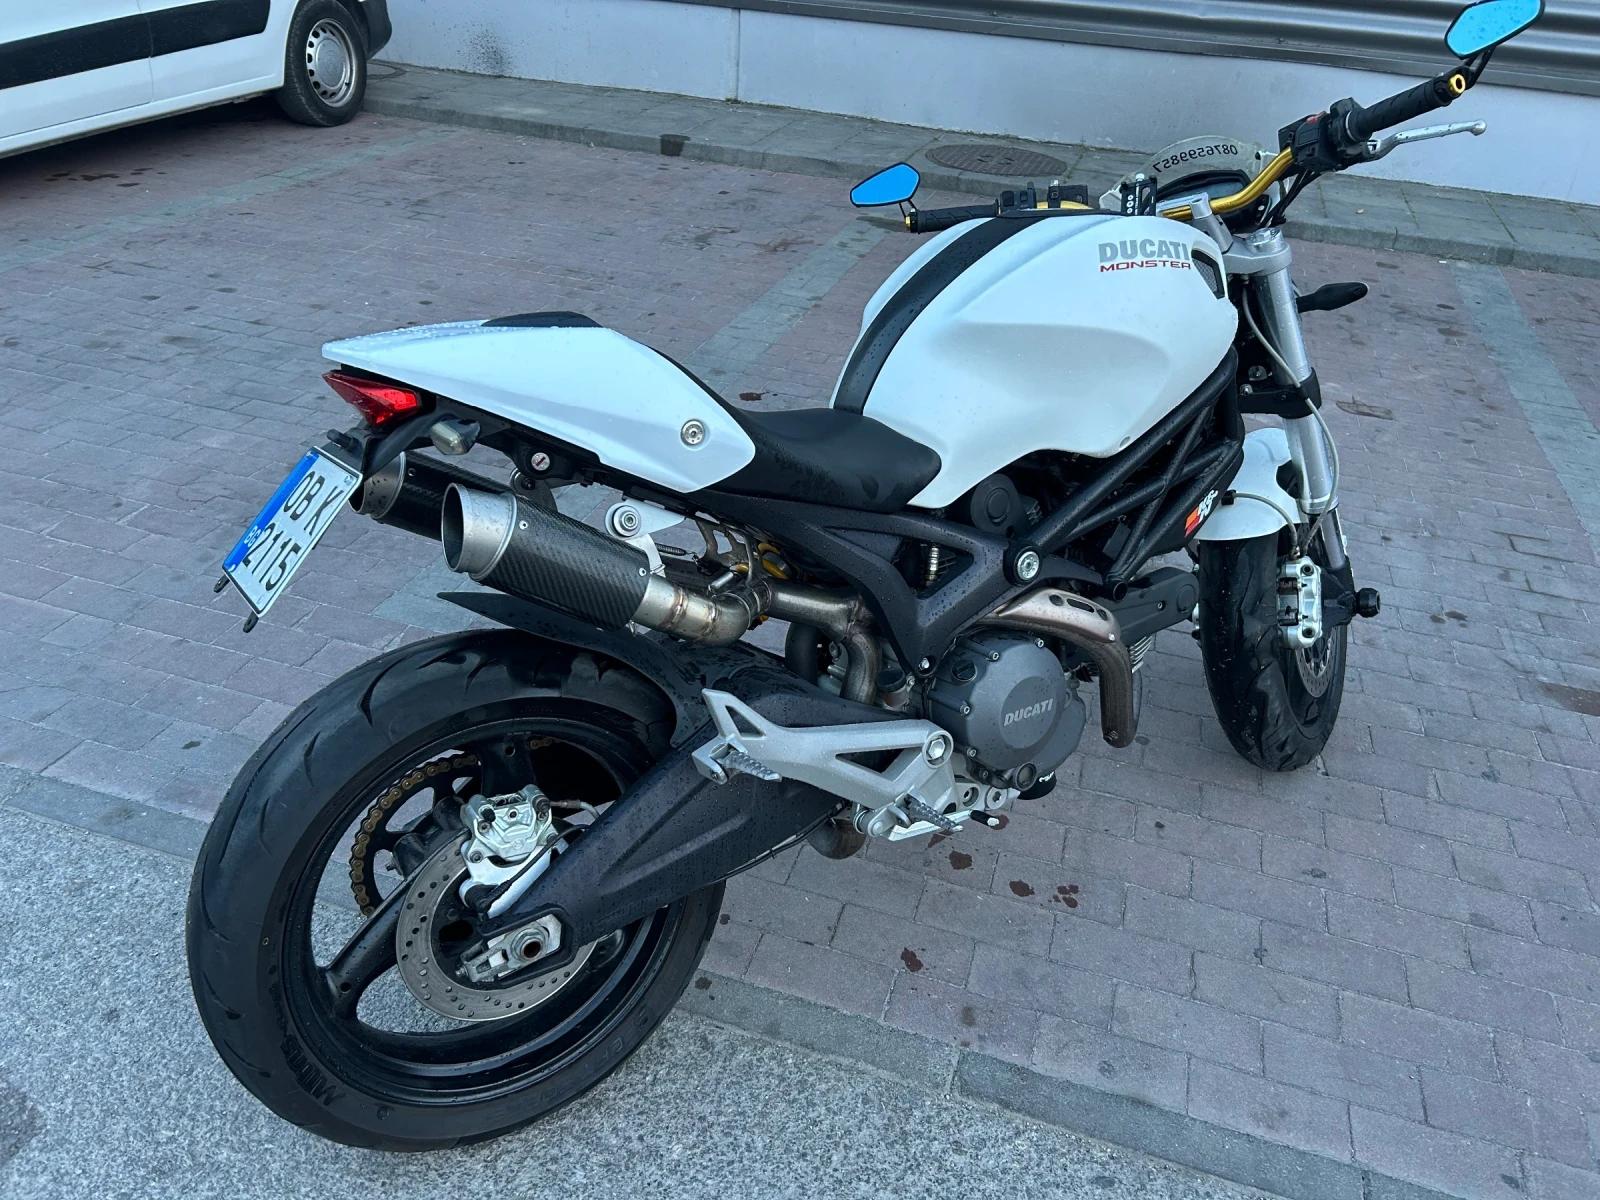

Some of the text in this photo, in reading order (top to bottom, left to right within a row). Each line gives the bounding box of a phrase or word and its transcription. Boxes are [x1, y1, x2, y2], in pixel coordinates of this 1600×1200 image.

[1098, 239, 1190, 262] DUCATI
[1100, 260, 1191, 273] MONSTER
[241, 522, 302, 591] 2115
[1003, 698, 1053, 727] DUCATI
